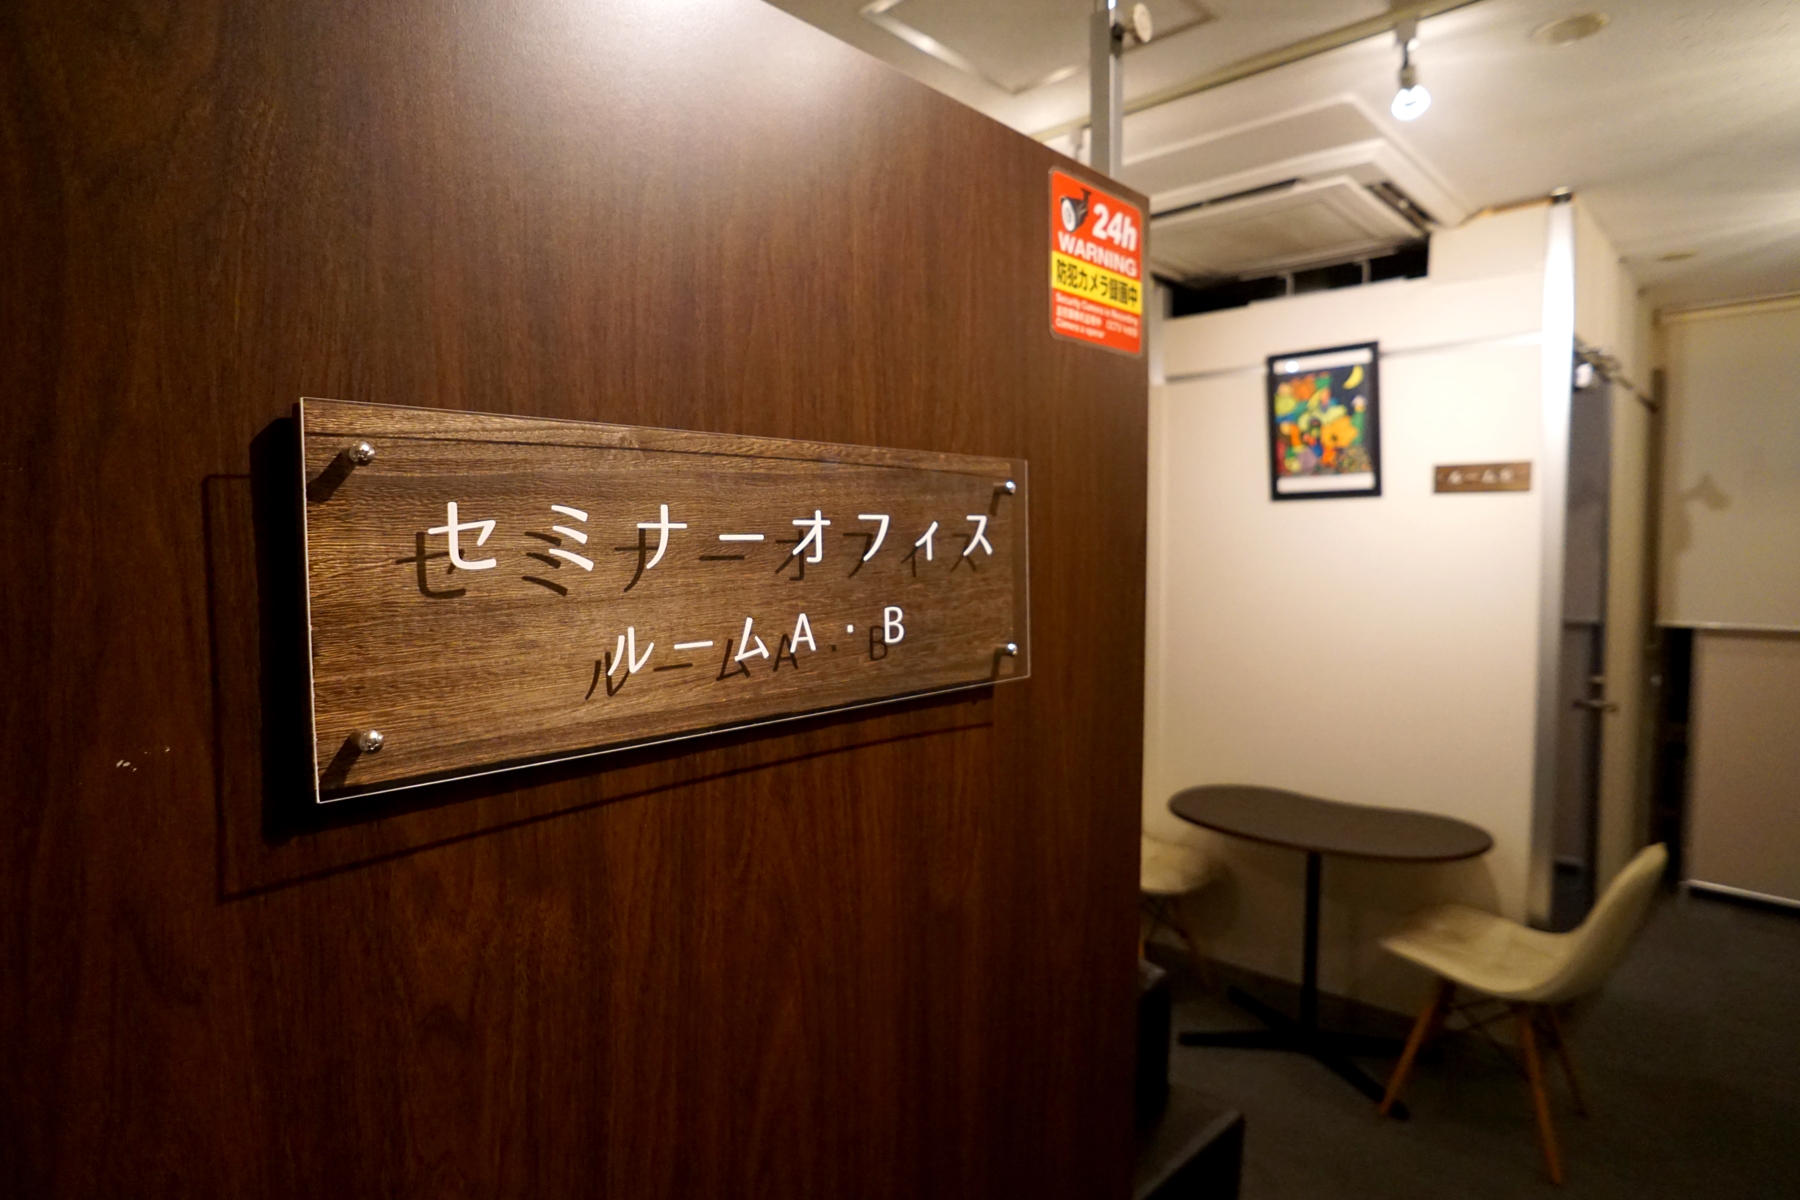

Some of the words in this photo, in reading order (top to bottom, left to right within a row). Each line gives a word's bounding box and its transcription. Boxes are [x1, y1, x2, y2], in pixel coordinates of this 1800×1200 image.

[1091, 203, 1138, 252] 24h
[1057, 230, 1138, 278] WARNING
[1056, 258, 1138, 307] 防犯カメラ録画中
[427, 501, 993, 572] セミナーオフィス
